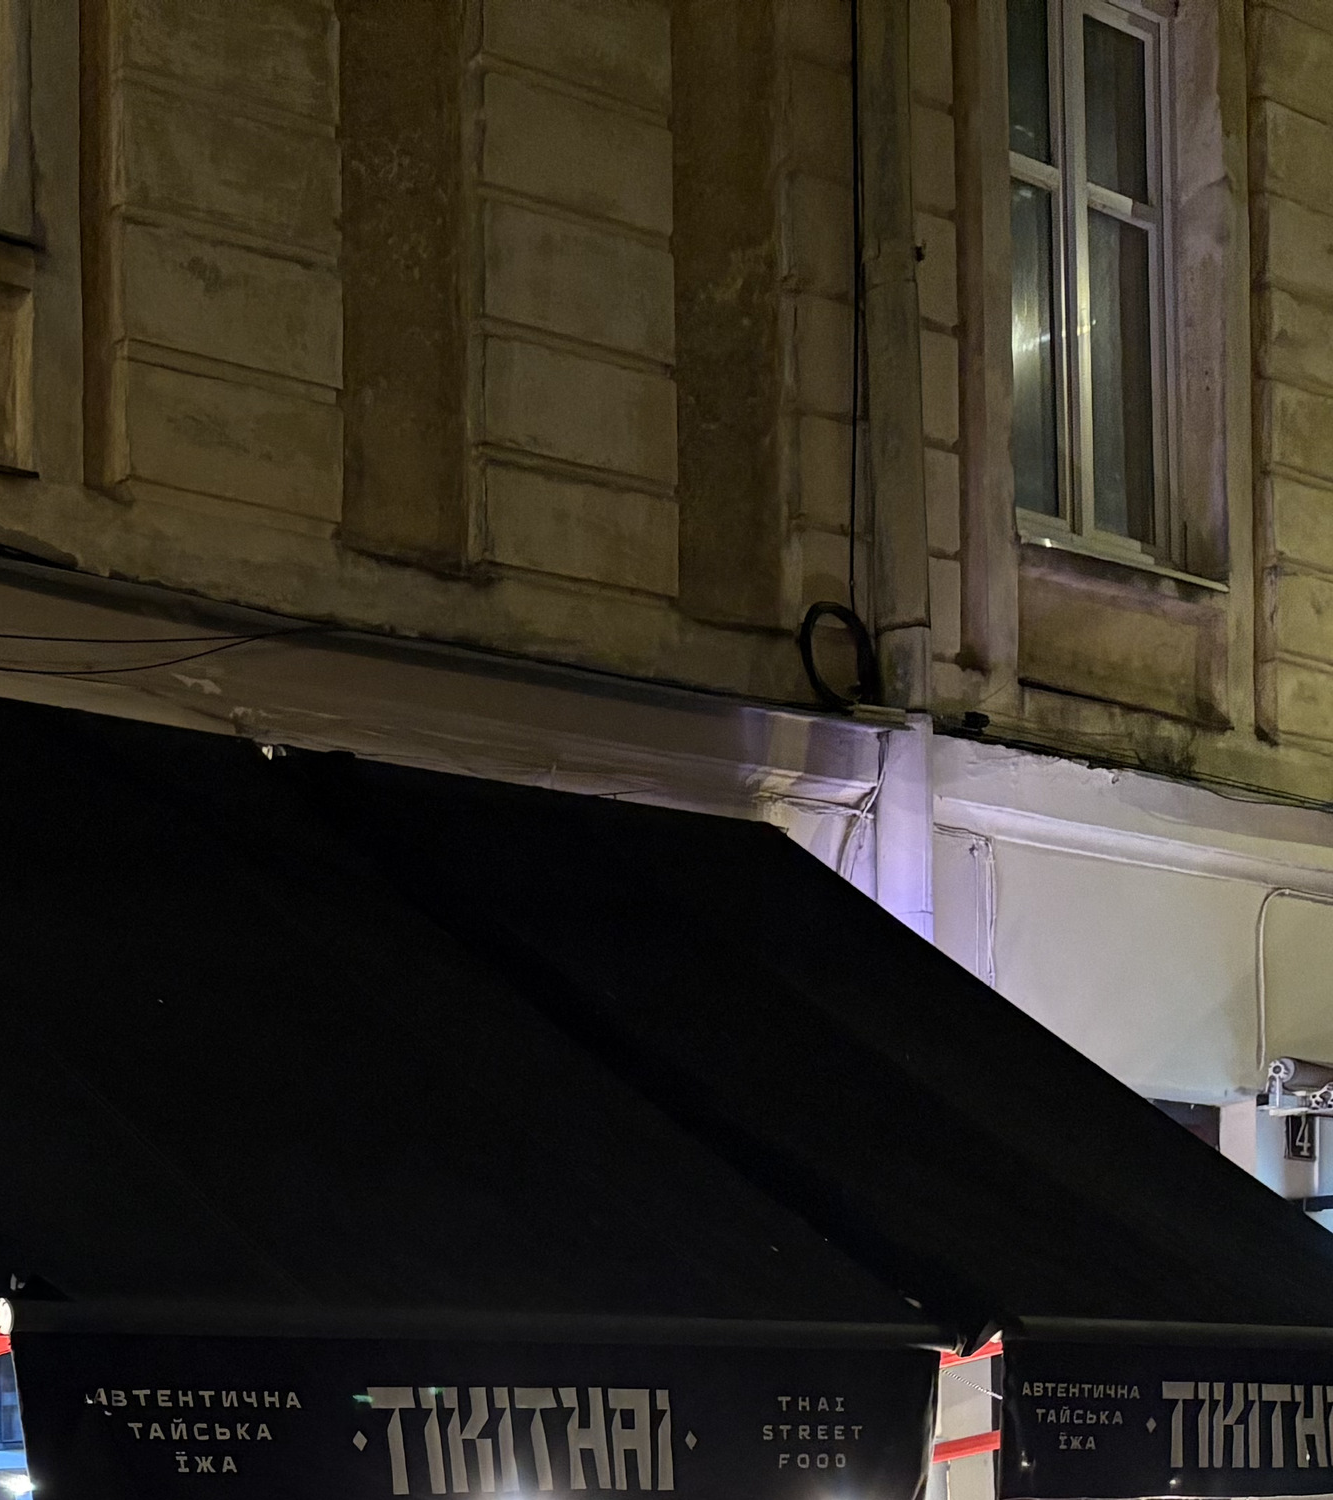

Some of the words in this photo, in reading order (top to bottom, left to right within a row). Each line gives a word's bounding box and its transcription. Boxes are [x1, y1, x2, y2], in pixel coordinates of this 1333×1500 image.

[93, 1387, 302, 1409] АВТЕНТИЧНА
[1021, 1381, 1141, 1399] АВТЕНТИЧНА
[777, 1396, 846, 1412] THAI
[1035, 1407, 1123, 1425] ТАЙСЬКА
[1161, 1381, 1333, 1469] TIKITH
[127, 1418, 273, 1441] ТАЙСЬКА
[762, 1424, 863, 1441] STREET
[366, 1386, 675, 1496] TIKITHAI
[1058, 1432, 1096, 1450] ЇЖА
[175, 1452, 238, 1473] ЇЖА
[778, 1453, 847, 1469] FOOD
